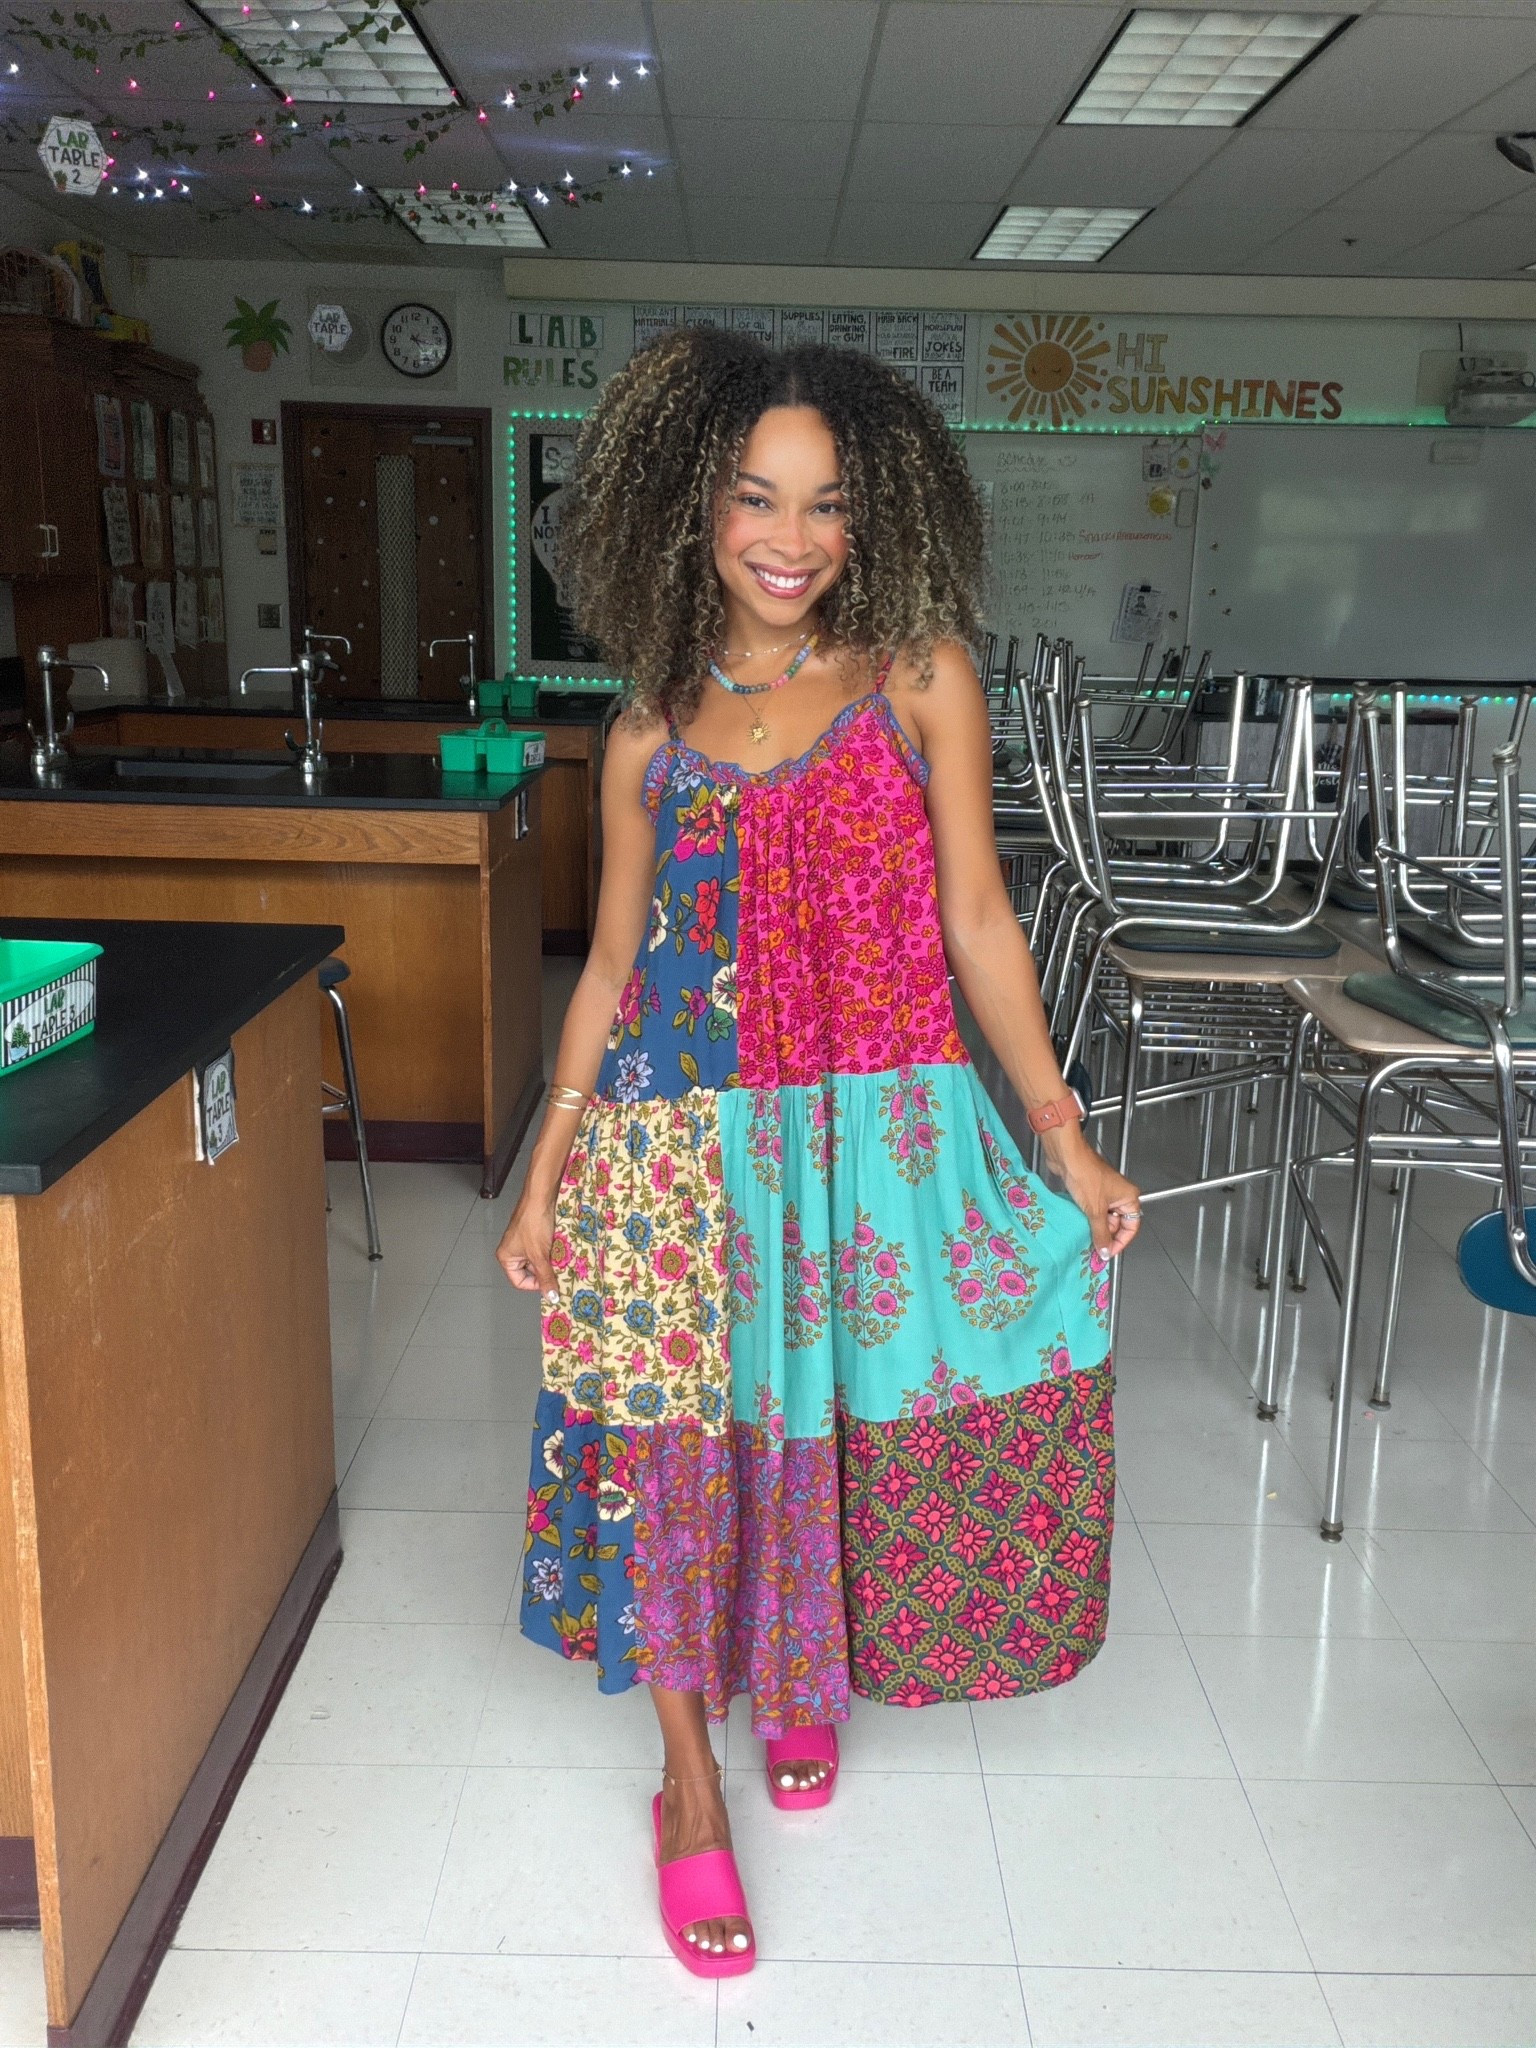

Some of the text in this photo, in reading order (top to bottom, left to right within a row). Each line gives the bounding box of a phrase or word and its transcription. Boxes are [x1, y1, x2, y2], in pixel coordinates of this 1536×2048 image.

[56, 128, 89, 150] LAB
[48, 145, 100, 169] TABLE
[72, 168, 81, 184] 2
[319, 310, 340, 323] LAB
[401, 315, 408, 323] 11
[411, 312, 421, 321] 12
[313, 322, 347, 335] TABLE
[392, 325, 402, 333] 10
[432, 326, 439, 334] 2
[518, 314, 598, 348] LAB
[328, 334, 333, 345] 1
[389, 335, 396, 344] 9
[435, 337, 442, 346] 3
[843, 333, 864, 343] GUM
[393, 348, 401, 356] 8
[893, 347, 914, 359] FIRE
[925, 341, 963, 353] JOKES
[1116, 332, 1168, 373] HI
[402, 355, 409, 365] 7
[503, 356, 599, 390] RULES
[931, 368, 951, 380] BE A
[928, 381, 957, 393] TEAM
[1106, 376, 1344, 420] SUNSHINES
[541, 506, 550, 525] I
[44, 988, 66, 1016] LAB
[32, 1004, 77, 1041] TABLE 3
[211, 1070, 227, 1100] LAB
[207, 1092, 231, 1128] TABLE
